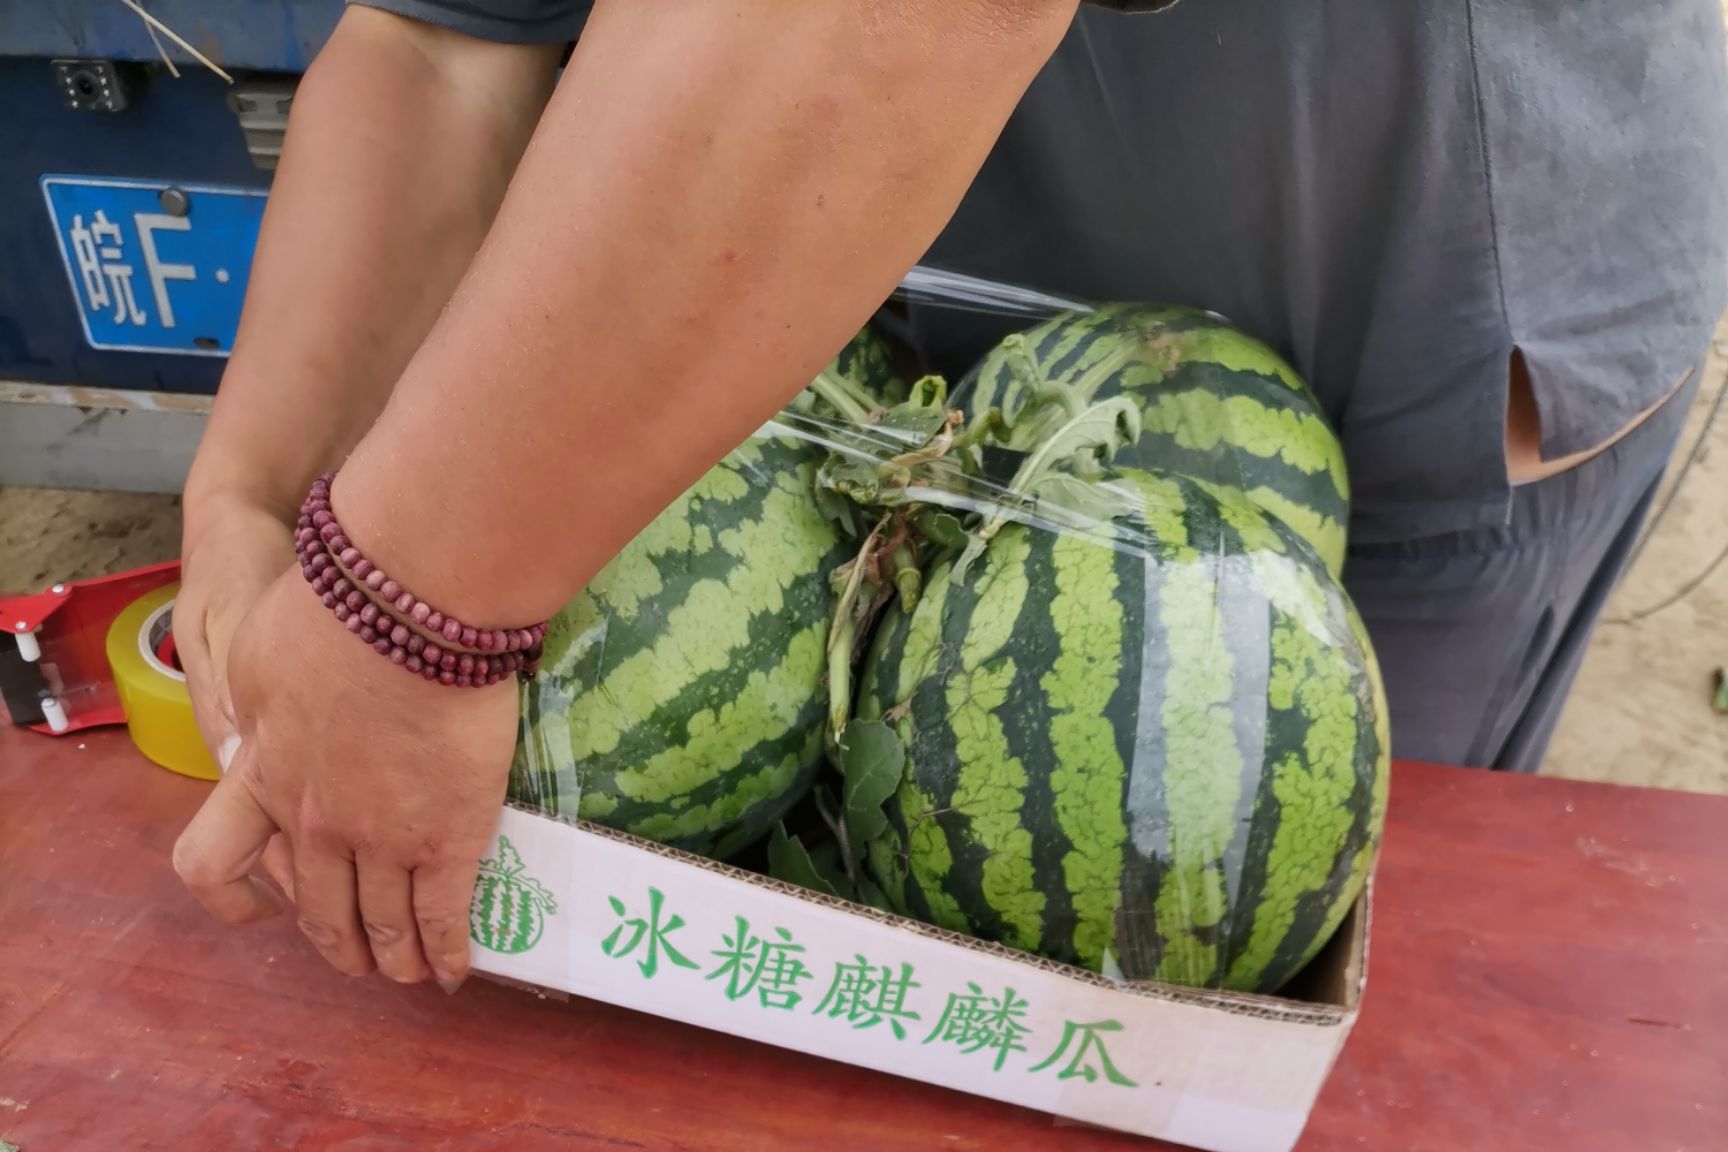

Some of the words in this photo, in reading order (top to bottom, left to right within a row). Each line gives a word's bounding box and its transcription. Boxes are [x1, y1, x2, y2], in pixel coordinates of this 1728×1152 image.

[600, 886, 1139, 1088] 冰糖麒麟瓜
